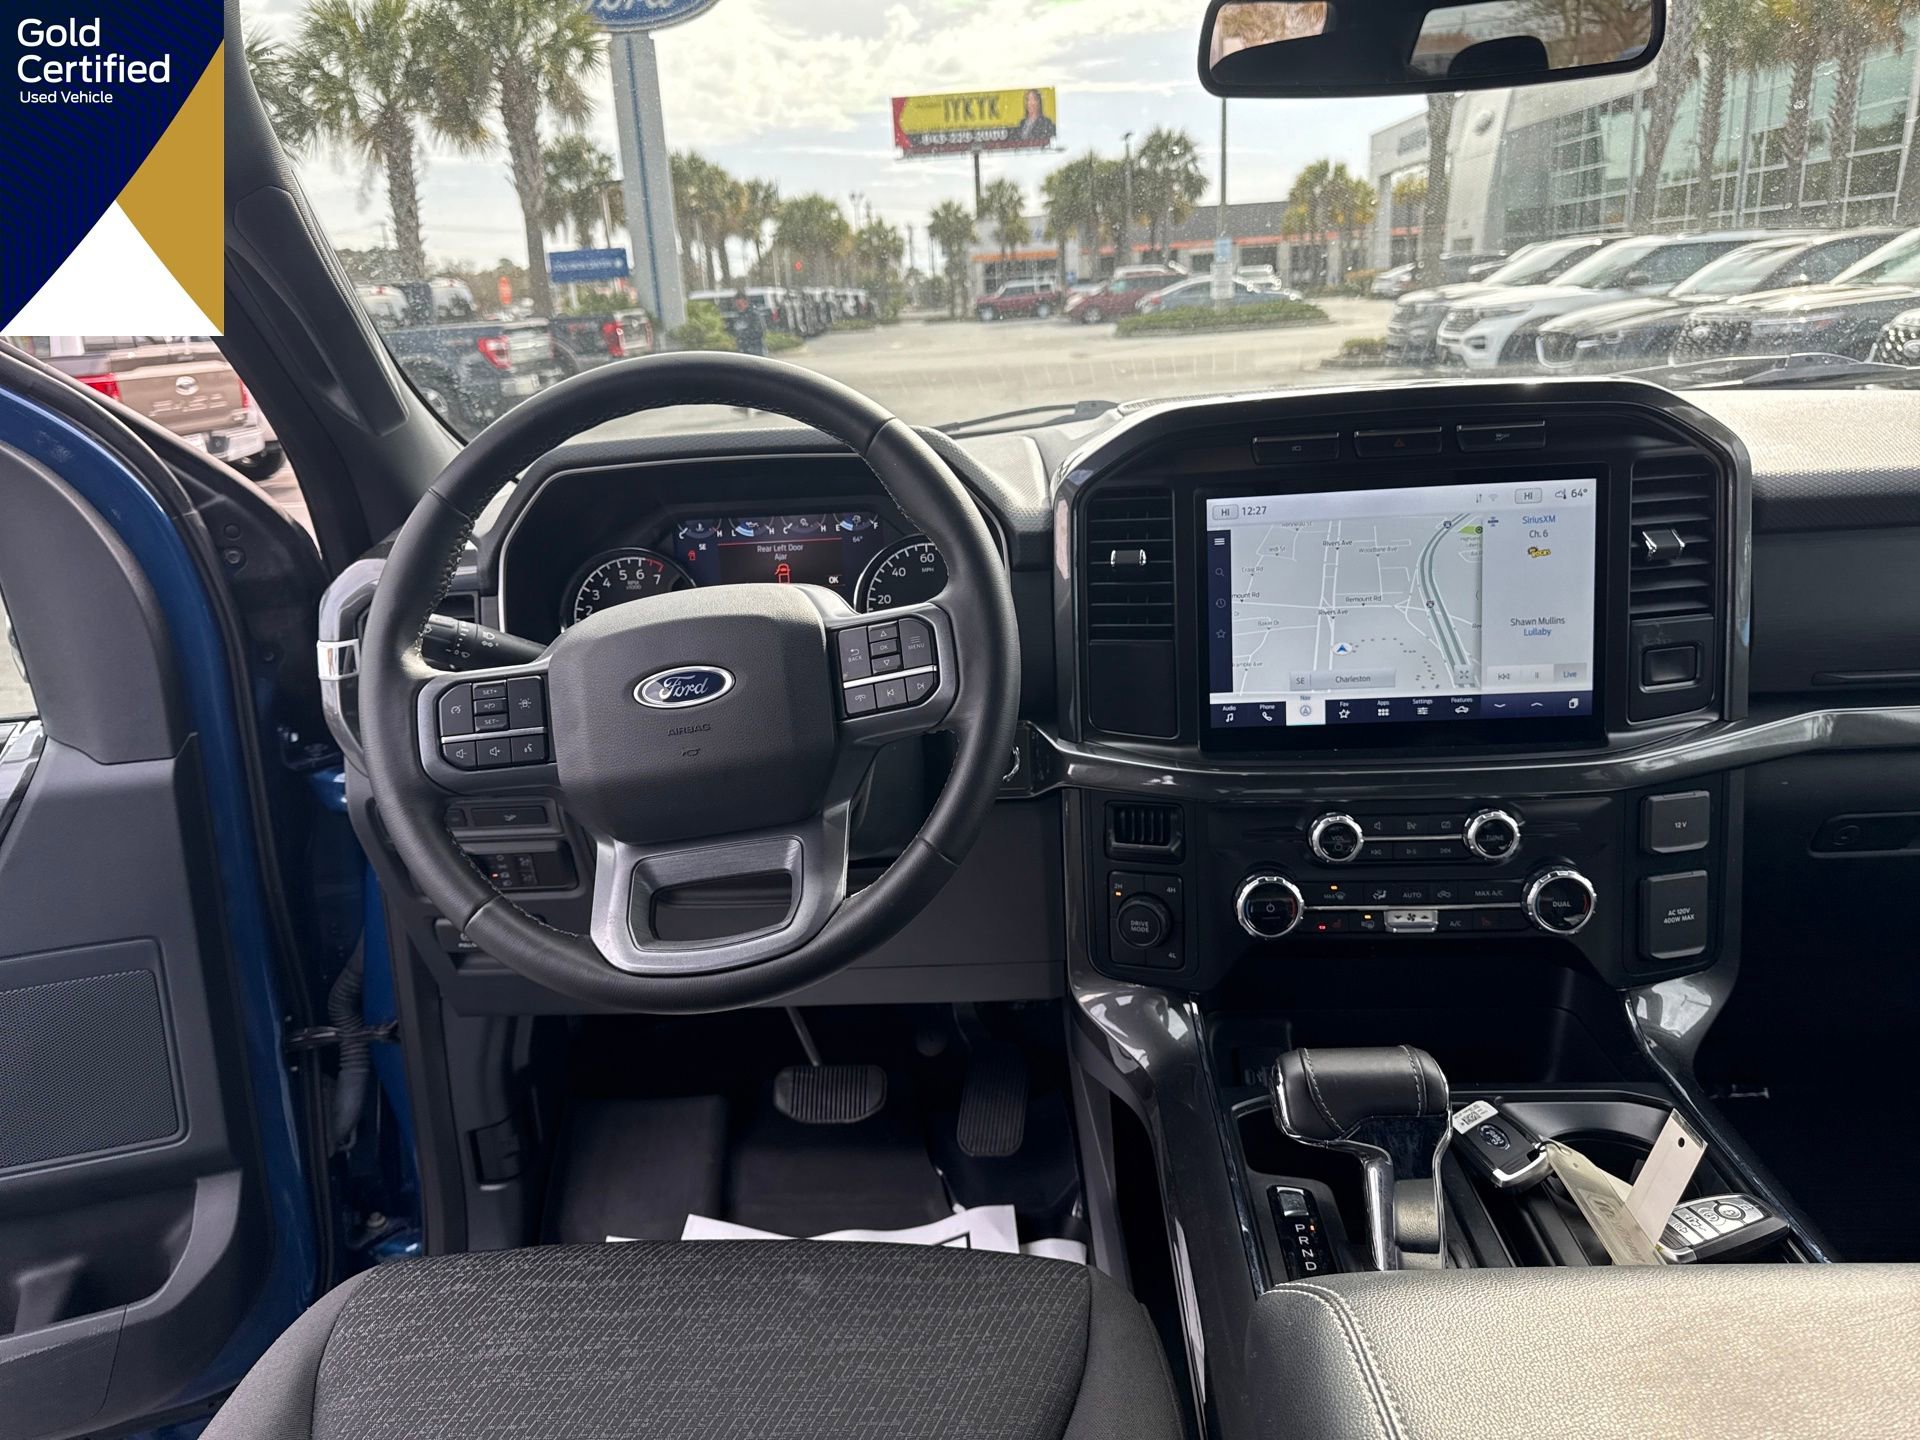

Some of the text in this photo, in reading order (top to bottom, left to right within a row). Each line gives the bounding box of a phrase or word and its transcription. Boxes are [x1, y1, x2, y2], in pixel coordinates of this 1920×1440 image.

[1571, 489, 1588, 498] 64°
[1221, 508, 1230, 517] HI
[1242, 506, 1267, 516] 12:27
[1522, 515, 1556, 525] SiriusXM
[788, 544, 804, 552] Door
[774, 553, 788, 561] Ajar
[920, 553, 934, 563] 60
[619, 569, 628, 581] 5
[636, 569, 645, 580] 6
[892, 567, 906, 577] 40
[602, 578, 612, 588] 4
[653, 574, 661, 585] 7
[828, 576, 839, 584] OK
[592, 590, 600, 600] 3
[878, 594, 892, 604] 20
[586, 605, 593, 616] 2
[1510, 616, 1566, 626] Shawn Mullins
[1524, 627, 1552, 637] Lullaby
[1335, 675, 1371, 684] Charleston
[1563, 670, 1578, 679] Live
[1296, 676, 1304, 685] SE
[658, 674, 708, 700] Ford
[1412, 698, 1434, 706] Settings
[668, 723, 711, 737] AIRBAG
[1552, 900, 1571, 908] DUAL
[1668, 909, 1676, 917] AC
[1682, 914, 1695, 922] MAX
[1294, 1224, 1306, 1232] P
[1298, 1236, 1310, 1245] R
[1302, 1248, 1314, 1258] N
[1305, 1261, 1317, 1271] D
